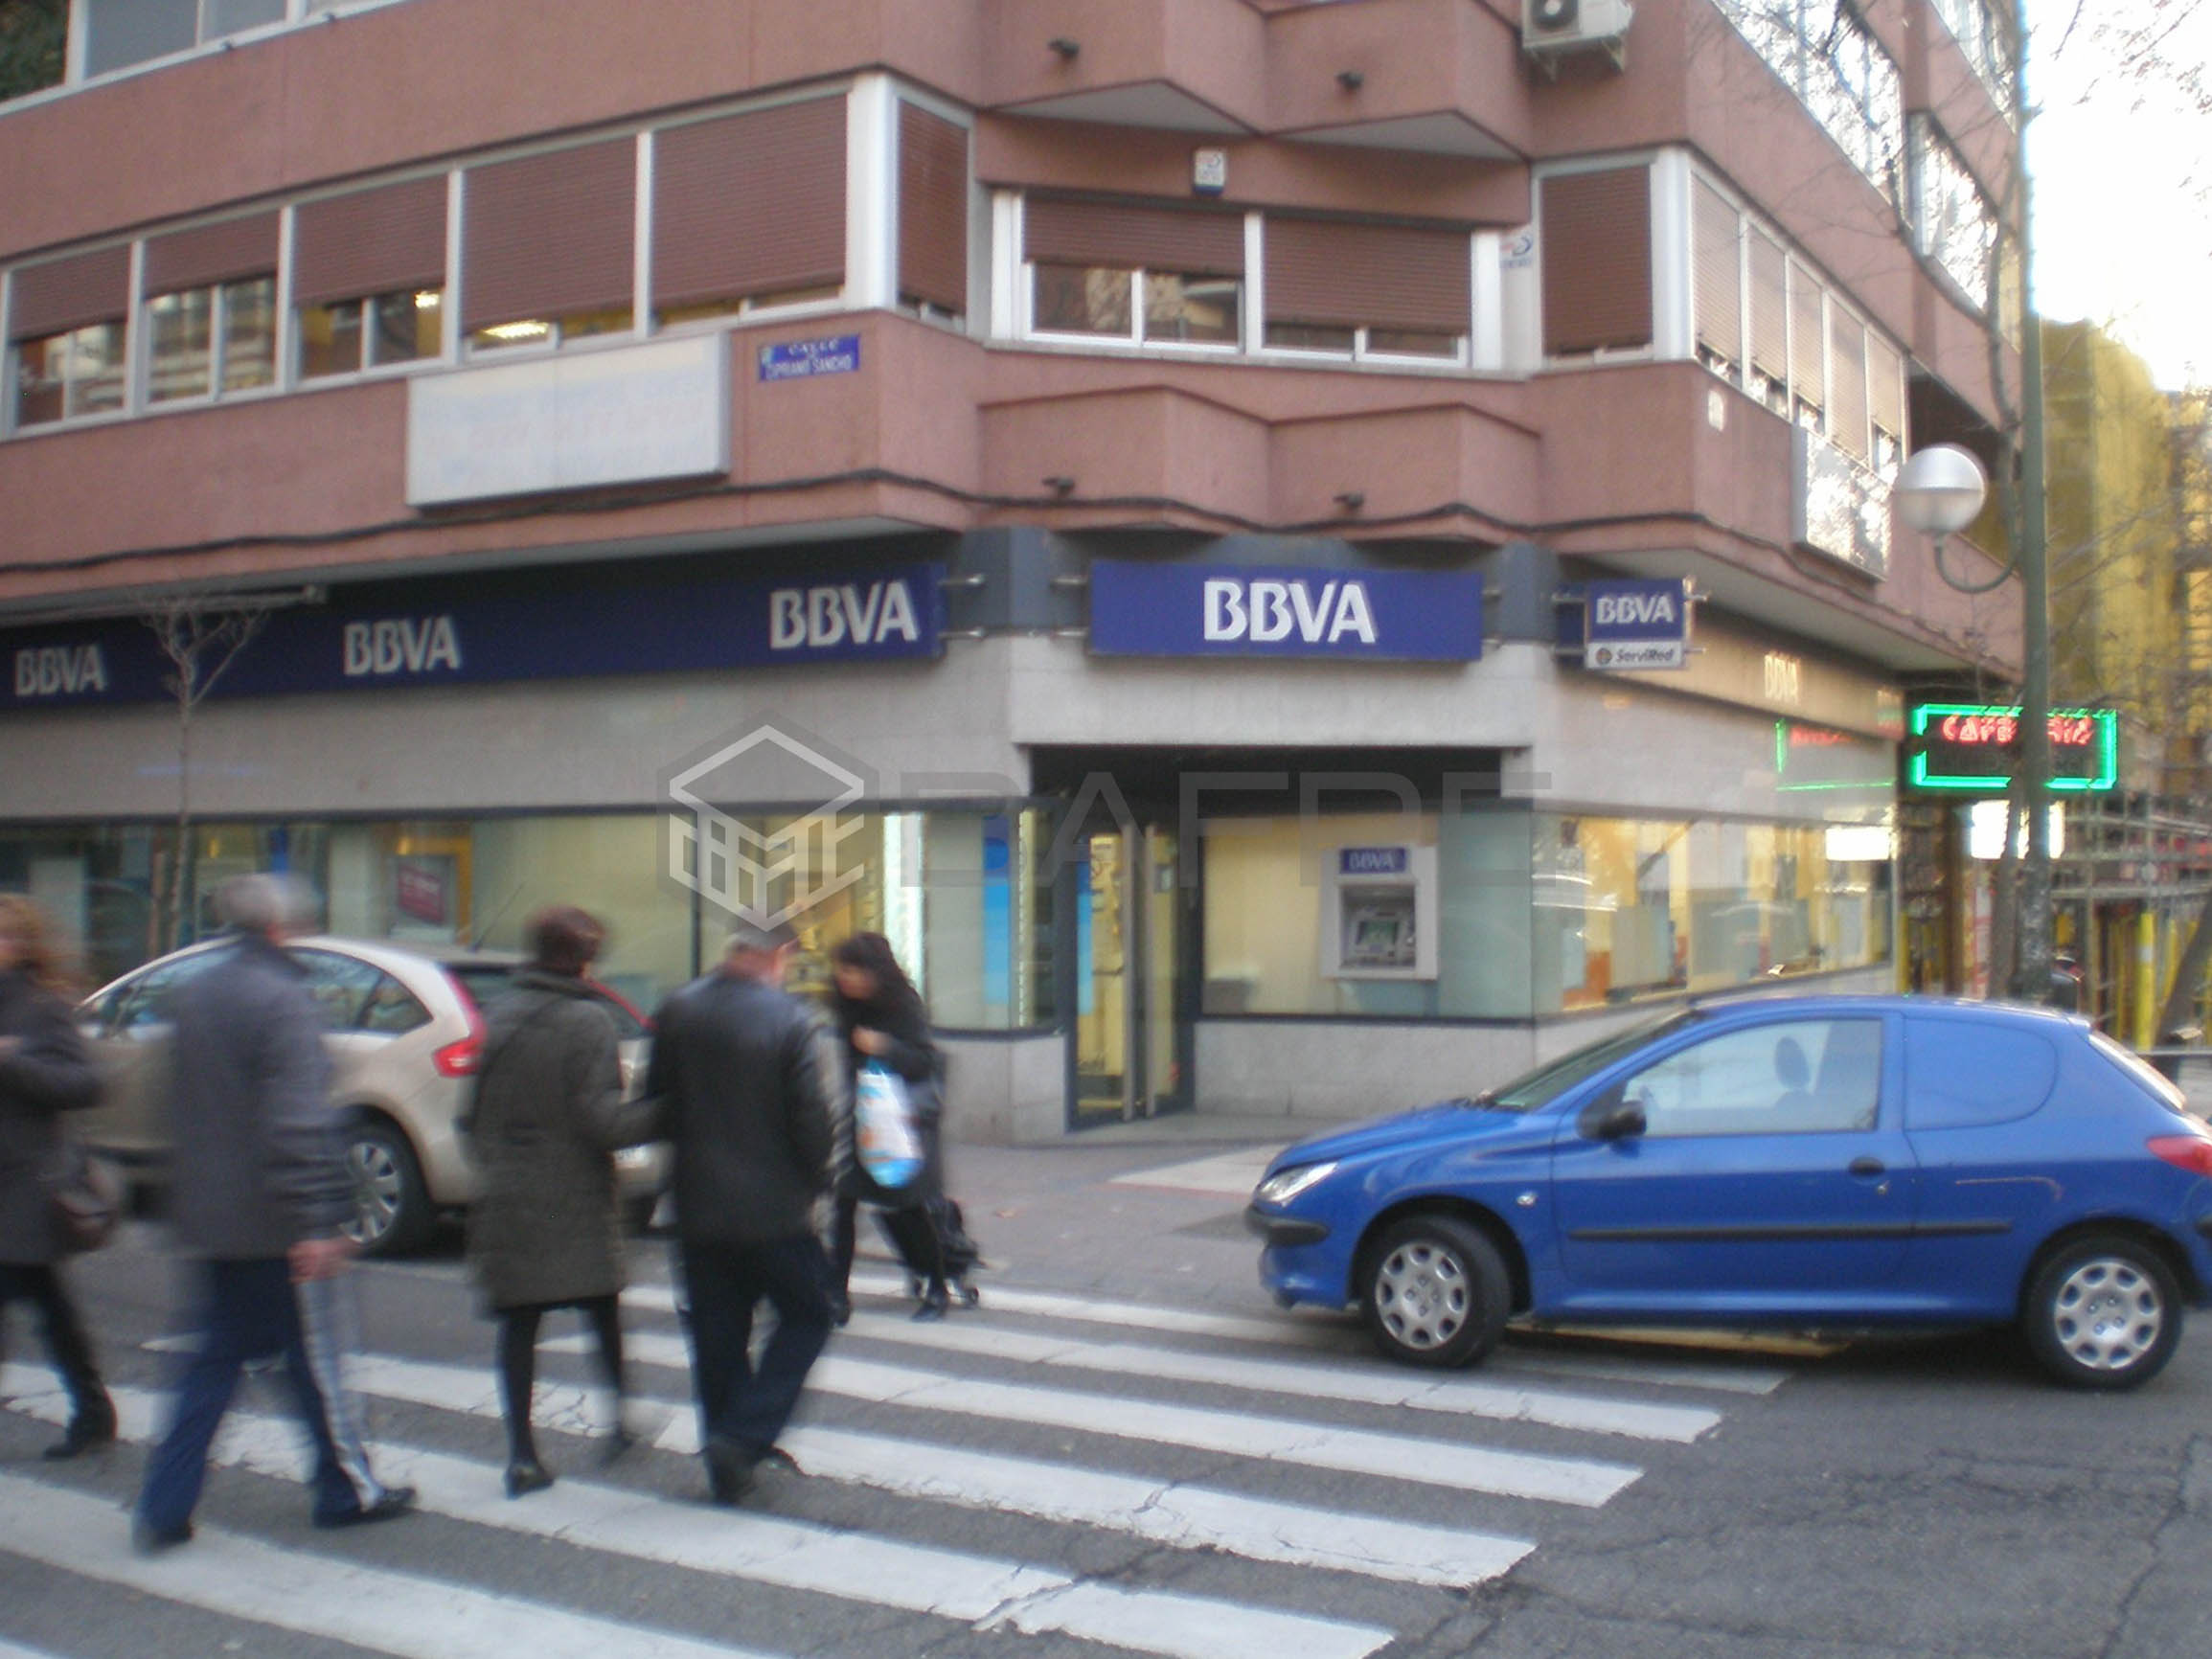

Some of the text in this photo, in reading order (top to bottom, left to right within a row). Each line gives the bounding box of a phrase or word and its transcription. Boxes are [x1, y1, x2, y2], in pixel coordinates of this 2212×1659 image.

[788, 338, 839, 356] CALLE
[811, 354, 852, 376] SANCHO
[770, 580, 919, 650] BBVA
[1203, 580, 1376, 644] BBVA
[1596, 593, 1674, 625] BBVA
[342, 616, 463, 676] BBVA
[1614, 647, 1675, 664] ServiRed
[14, 644, 107, 696] BBVA
[1348, 851, 1396, 870] BBVA
